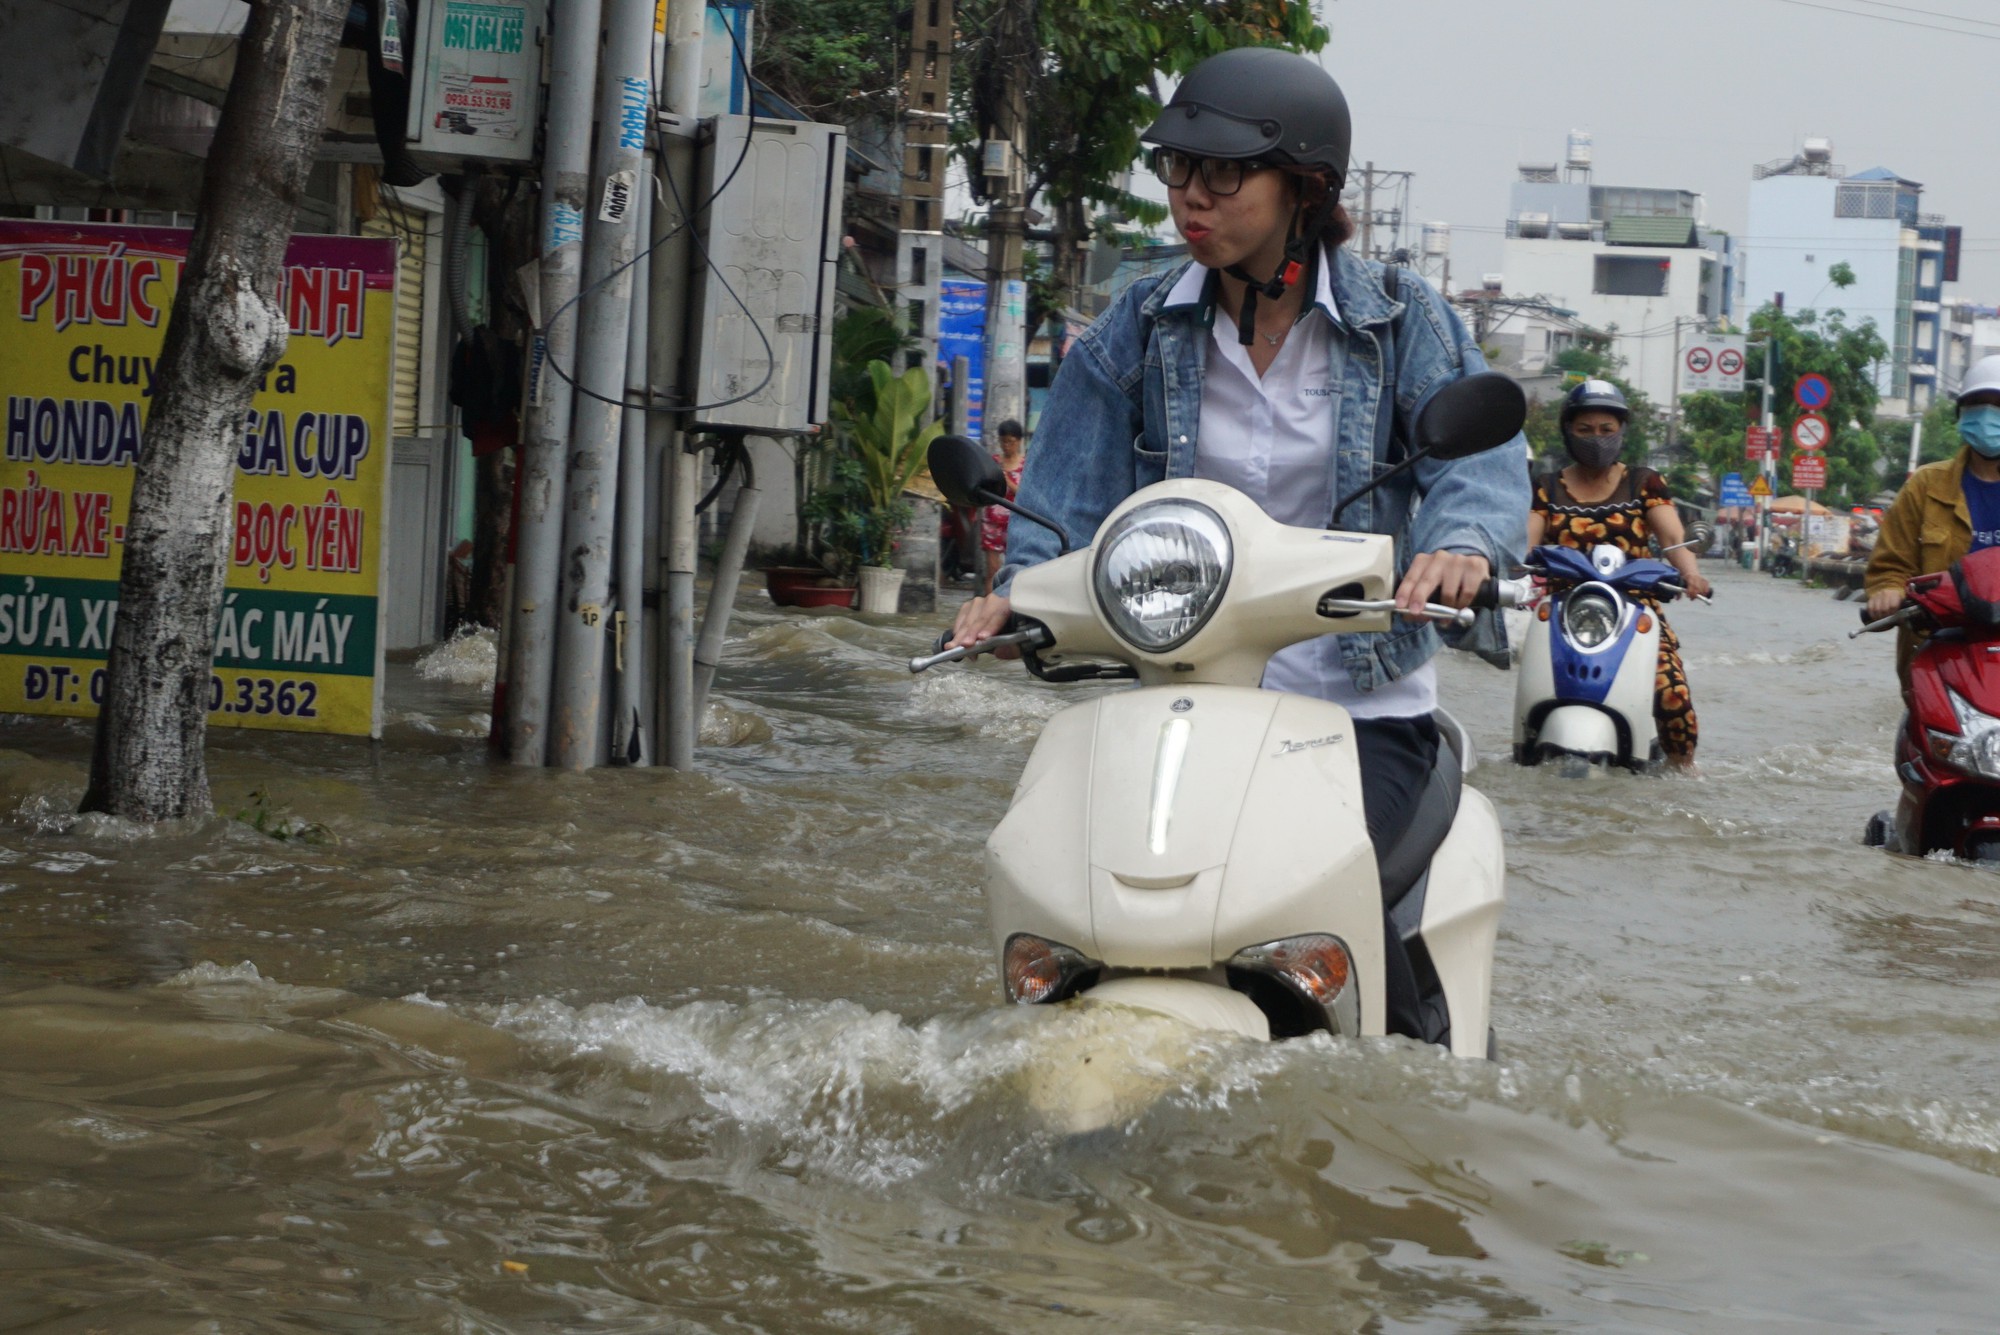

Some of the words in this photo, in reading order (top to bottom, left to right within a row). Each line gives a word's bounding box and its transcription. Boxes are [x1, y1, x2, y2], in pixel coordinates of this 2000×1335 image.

[19, 241, 163, 332] PHÚC
[6, 396, 143, 467] HONDA
[293, 411, 370, 480] CUP
[0, 469, 69, 555] RỬA
[234, 501, 298, 583] BỌC
[303, 488, 365, 573] YÊN
[214, 592, 264, 660] ÁC
[272, 598, 354, 664] MÁY
[25, 664, 80, 703] ĐT:
